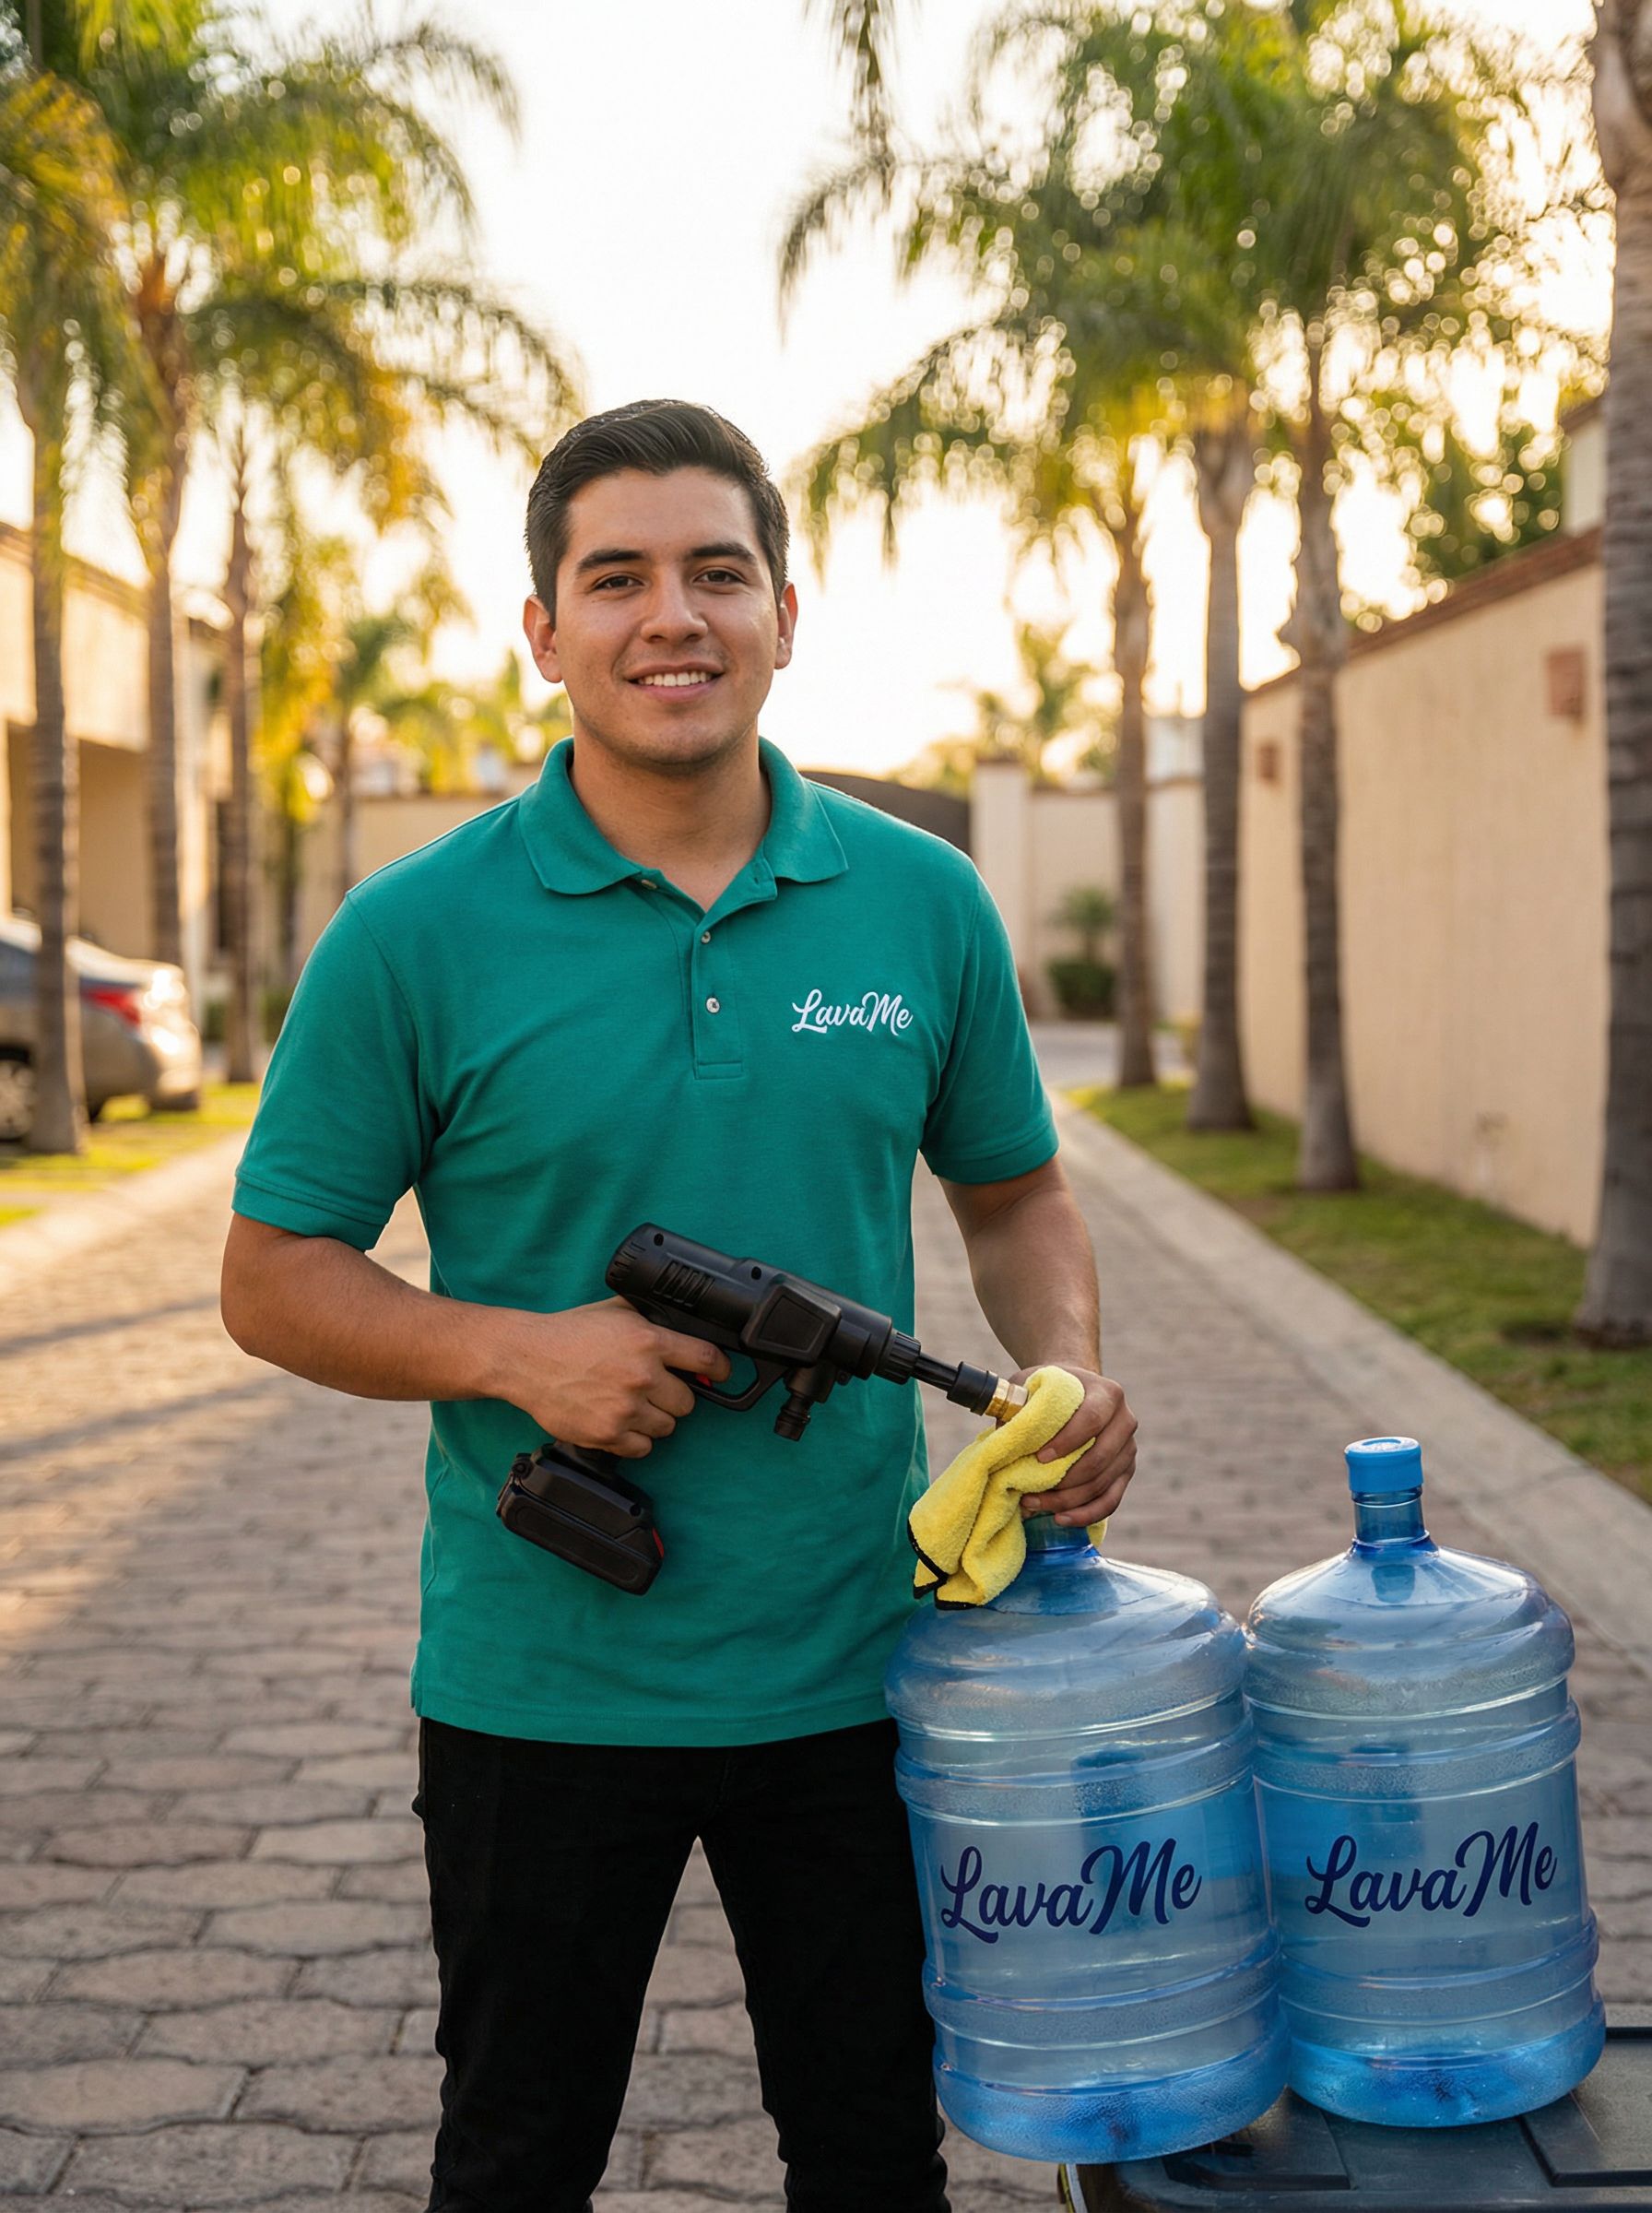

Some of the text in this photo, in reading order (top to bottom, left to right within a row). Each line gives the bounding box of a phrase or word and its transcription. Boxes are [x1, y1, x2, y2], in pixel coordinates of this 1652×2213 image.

[791, 988, 914, 1037] LavaMe
[940, 1838, 1202, 1943] LavaMe
[1306, 1822, 1558, 1927] LavaMe
